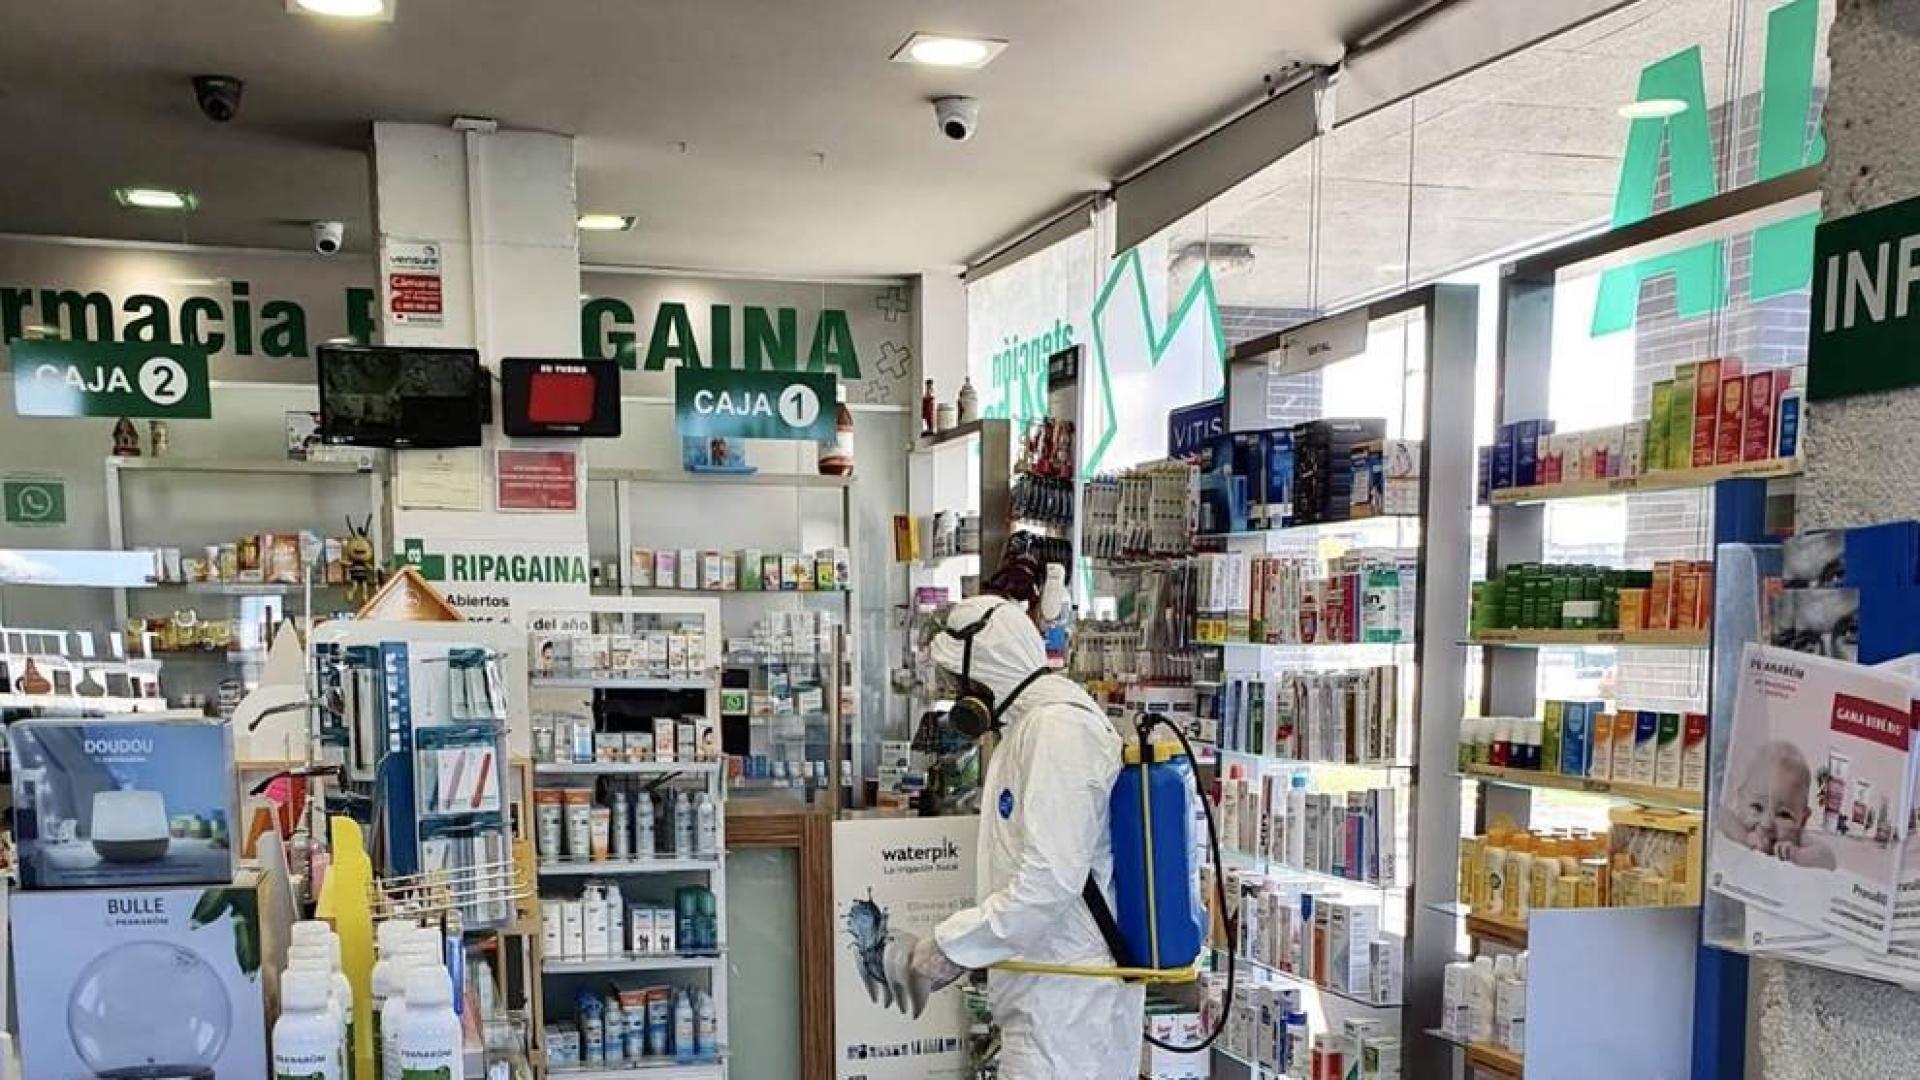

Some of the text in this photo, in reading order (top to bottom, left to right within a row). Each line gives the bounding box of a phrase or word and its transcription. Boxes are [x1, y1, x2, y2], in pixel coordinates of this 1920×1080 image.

[35, 363, 176, 396] CAJA 2
[694, 388, 804, 420] CAJA 1
[1174, 416, 1223, 447] VITIS
[451, 554, 587, 583] RIPAGAINA
[446, 593, 511, 608] Abiertos
[533, 618, 588, 631] del año
[84, 738, 154, 753] DOUDOU
[882, 835, 959, 863] waterpik
[107, 897, 166, 914] BULLE
